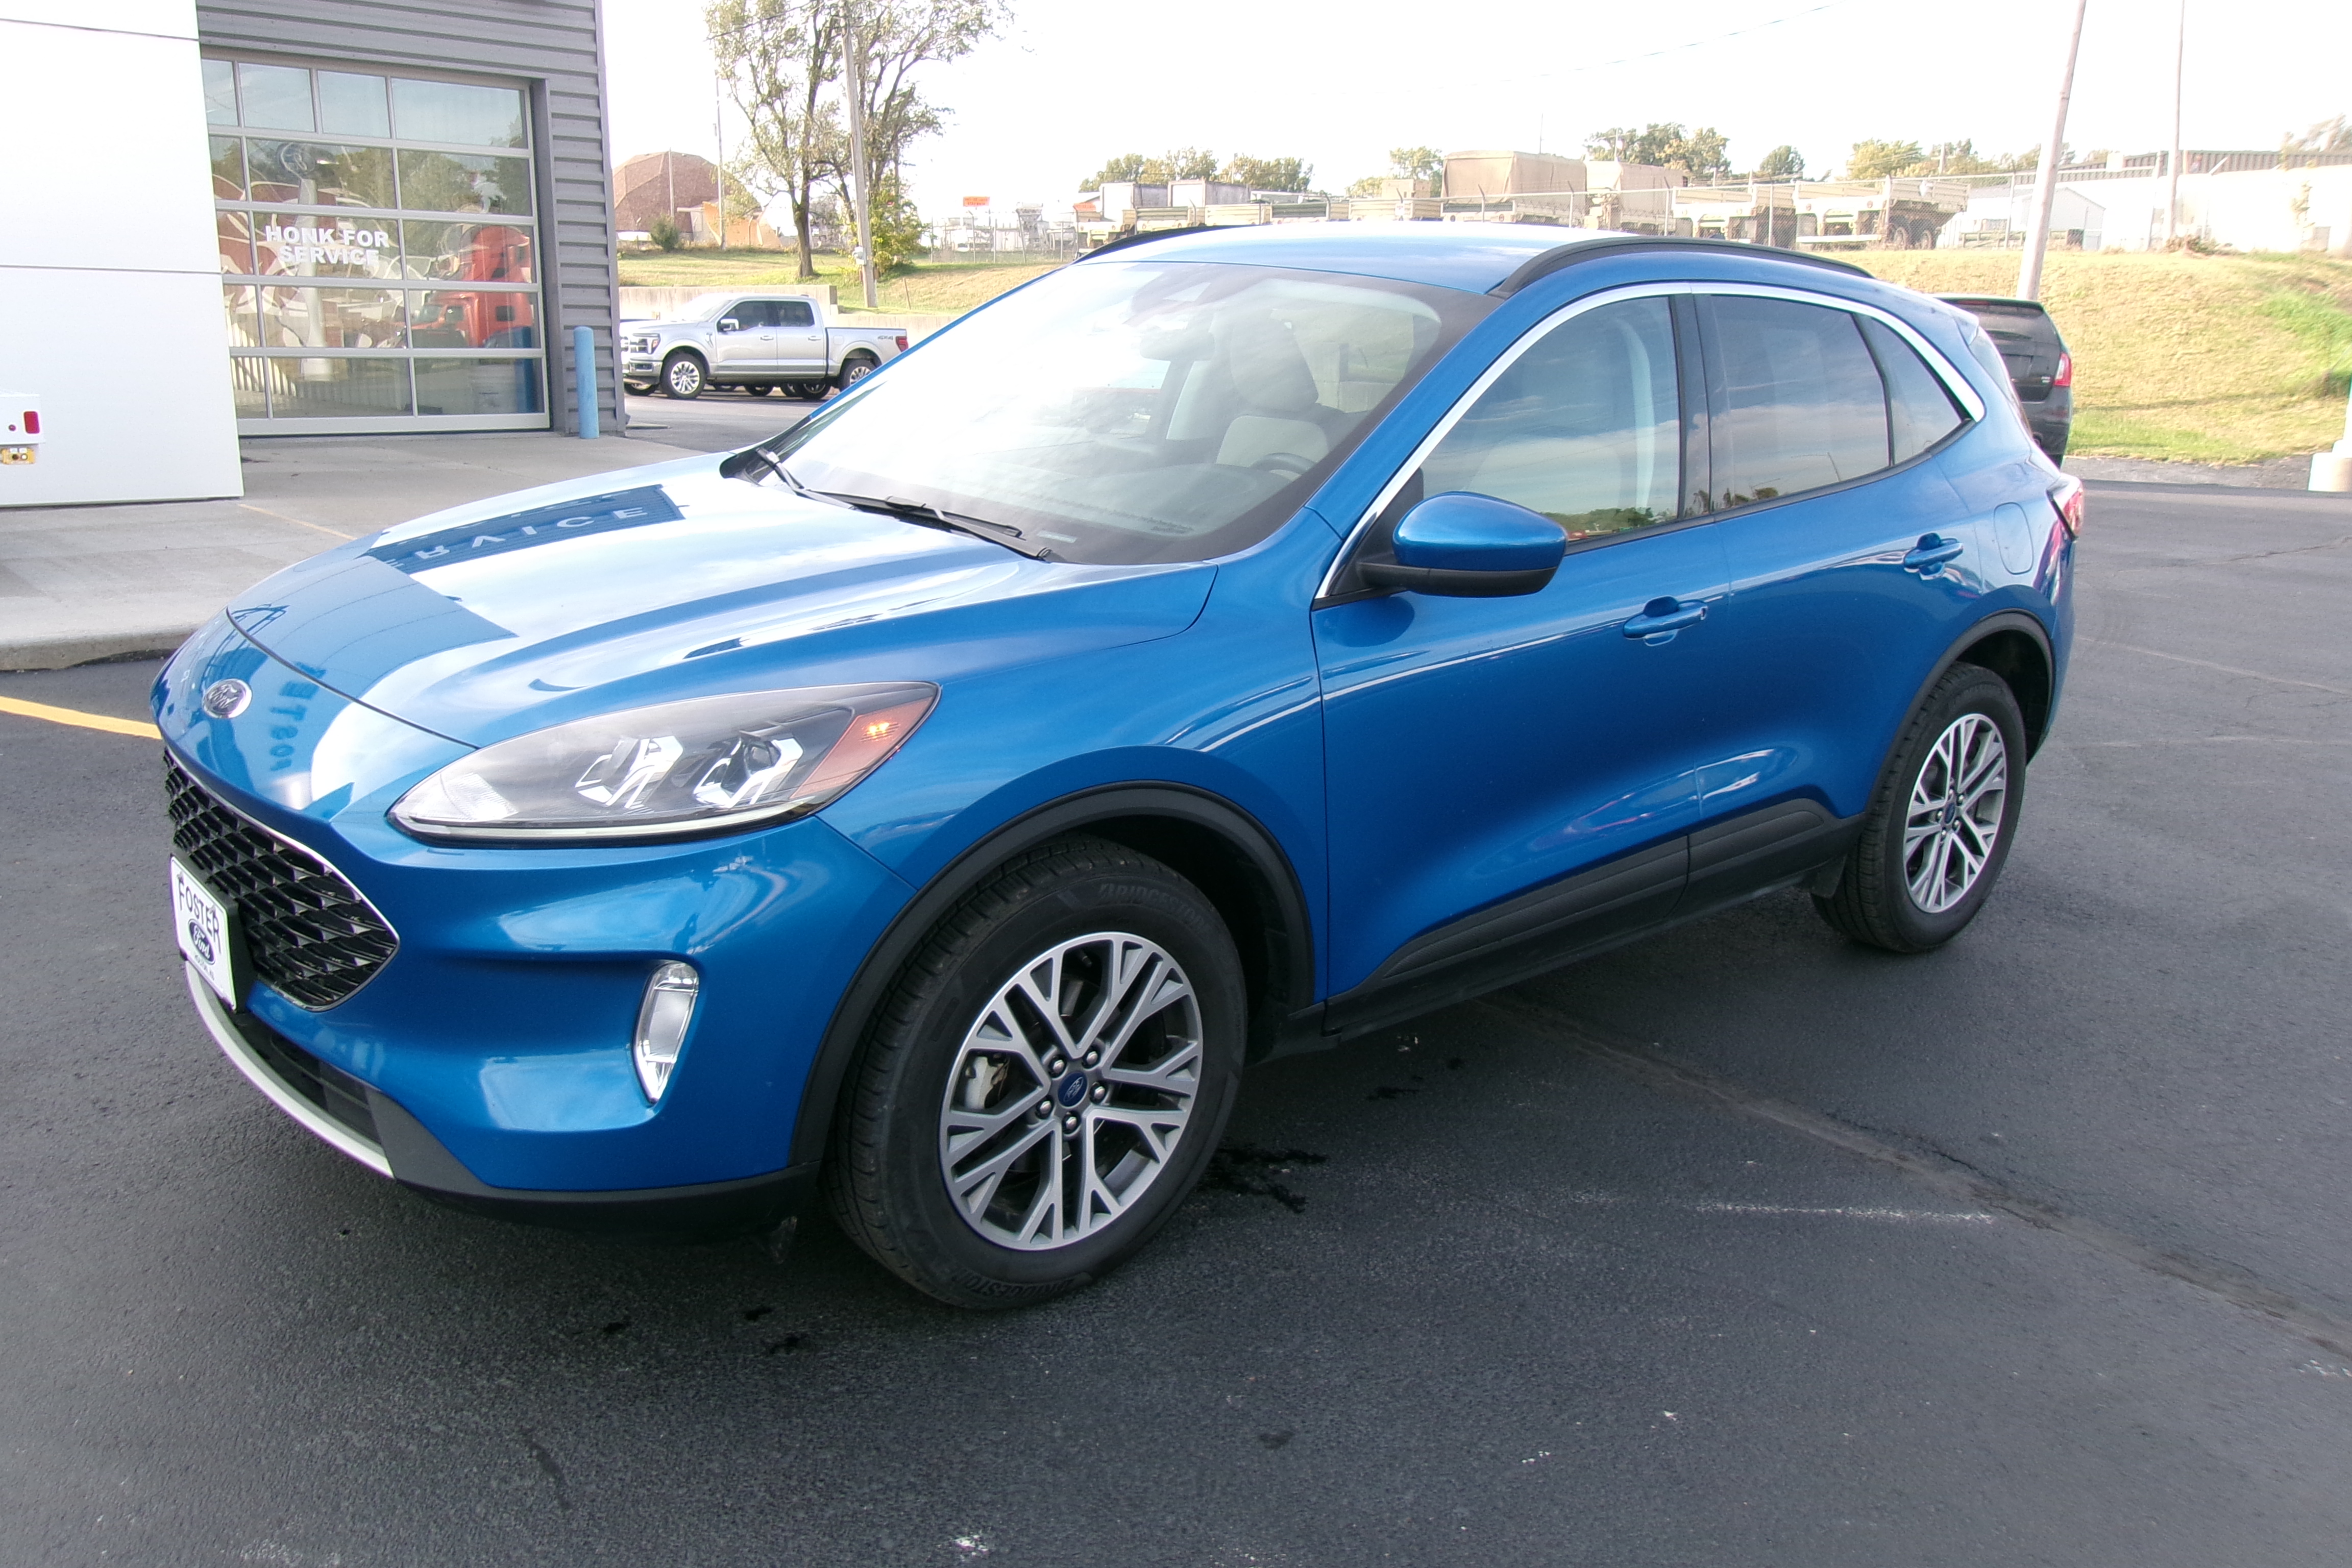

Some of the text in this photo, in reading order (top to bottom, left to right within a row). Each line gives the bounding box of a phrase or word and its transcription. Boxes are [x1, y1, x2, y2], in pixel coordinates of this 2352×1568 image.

[265, 226, 390, 248] HONK FOR
[279, 245, 379, 267] SERVICE
[178, 878, 222, 954] FOSTER
[192, 924, 211, 959] Ford
